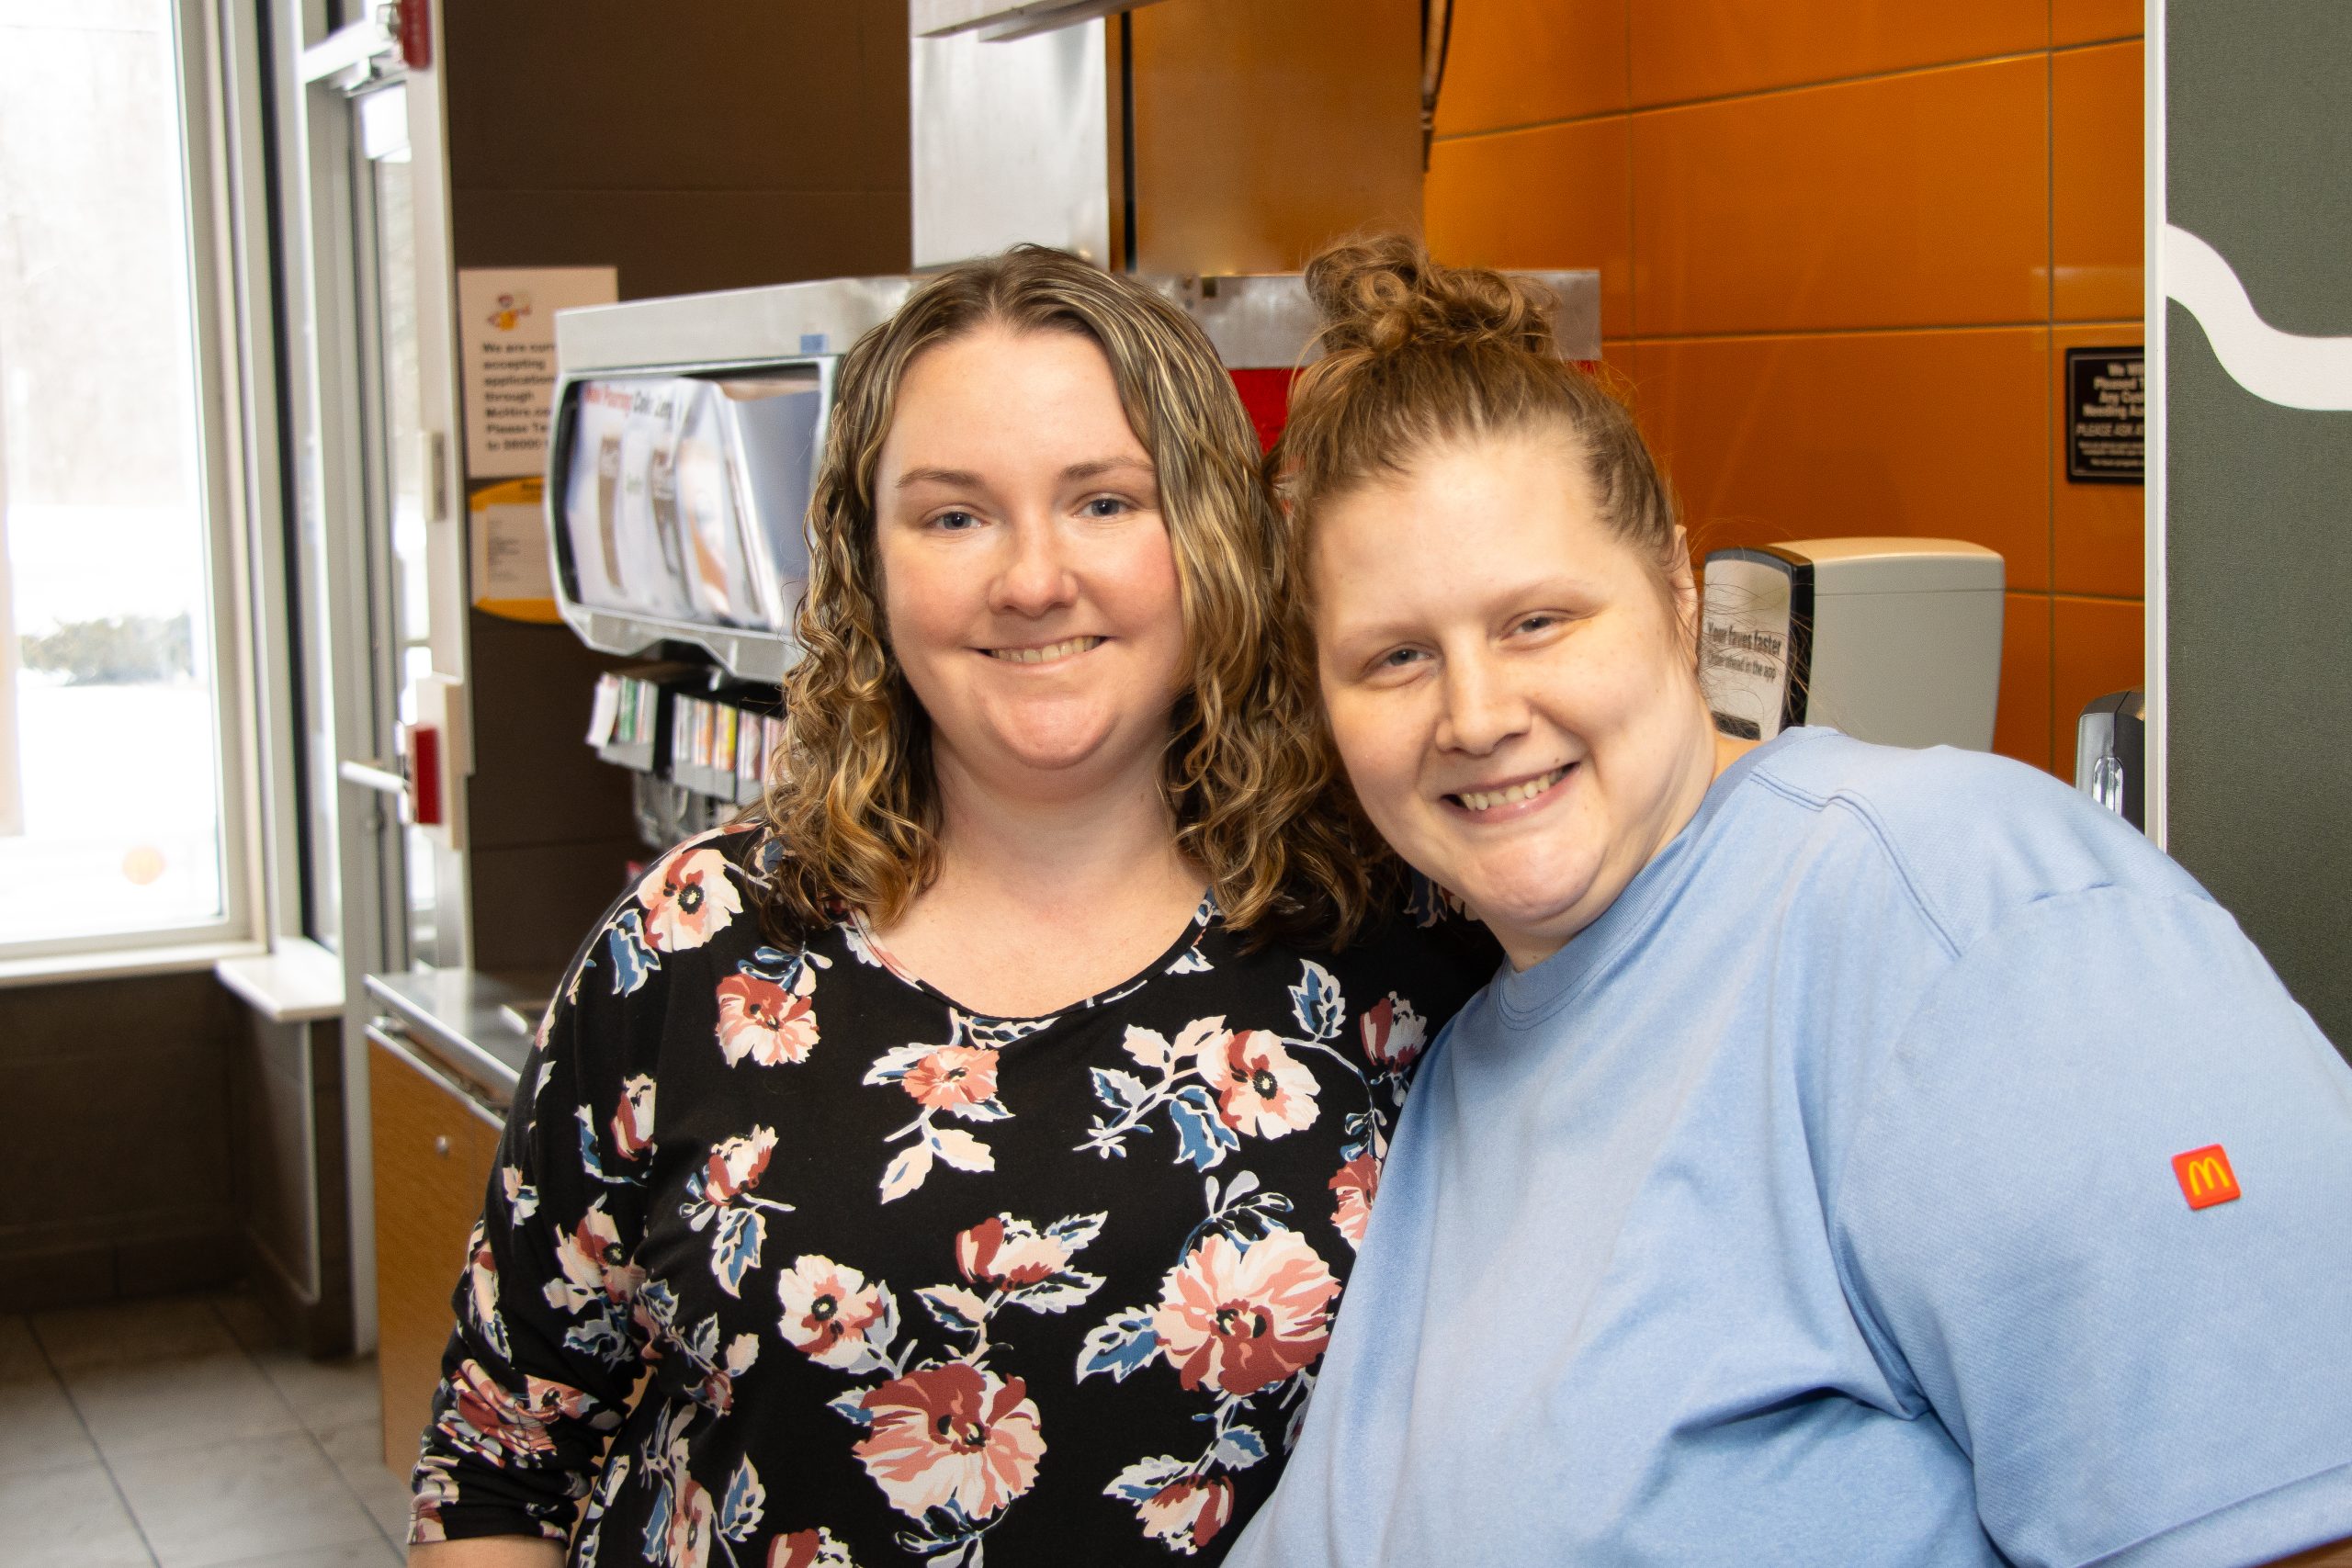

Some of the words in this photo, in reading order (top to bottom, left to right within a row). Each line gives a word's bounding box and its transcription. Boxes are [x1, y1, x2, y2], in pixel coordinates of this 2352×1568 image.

[484, 360, 546, 371] accepting
[485, 376, 557, 387] application
[1707, 621, 1727, 643] Your
[1753, 629, 1781, 655] faster
